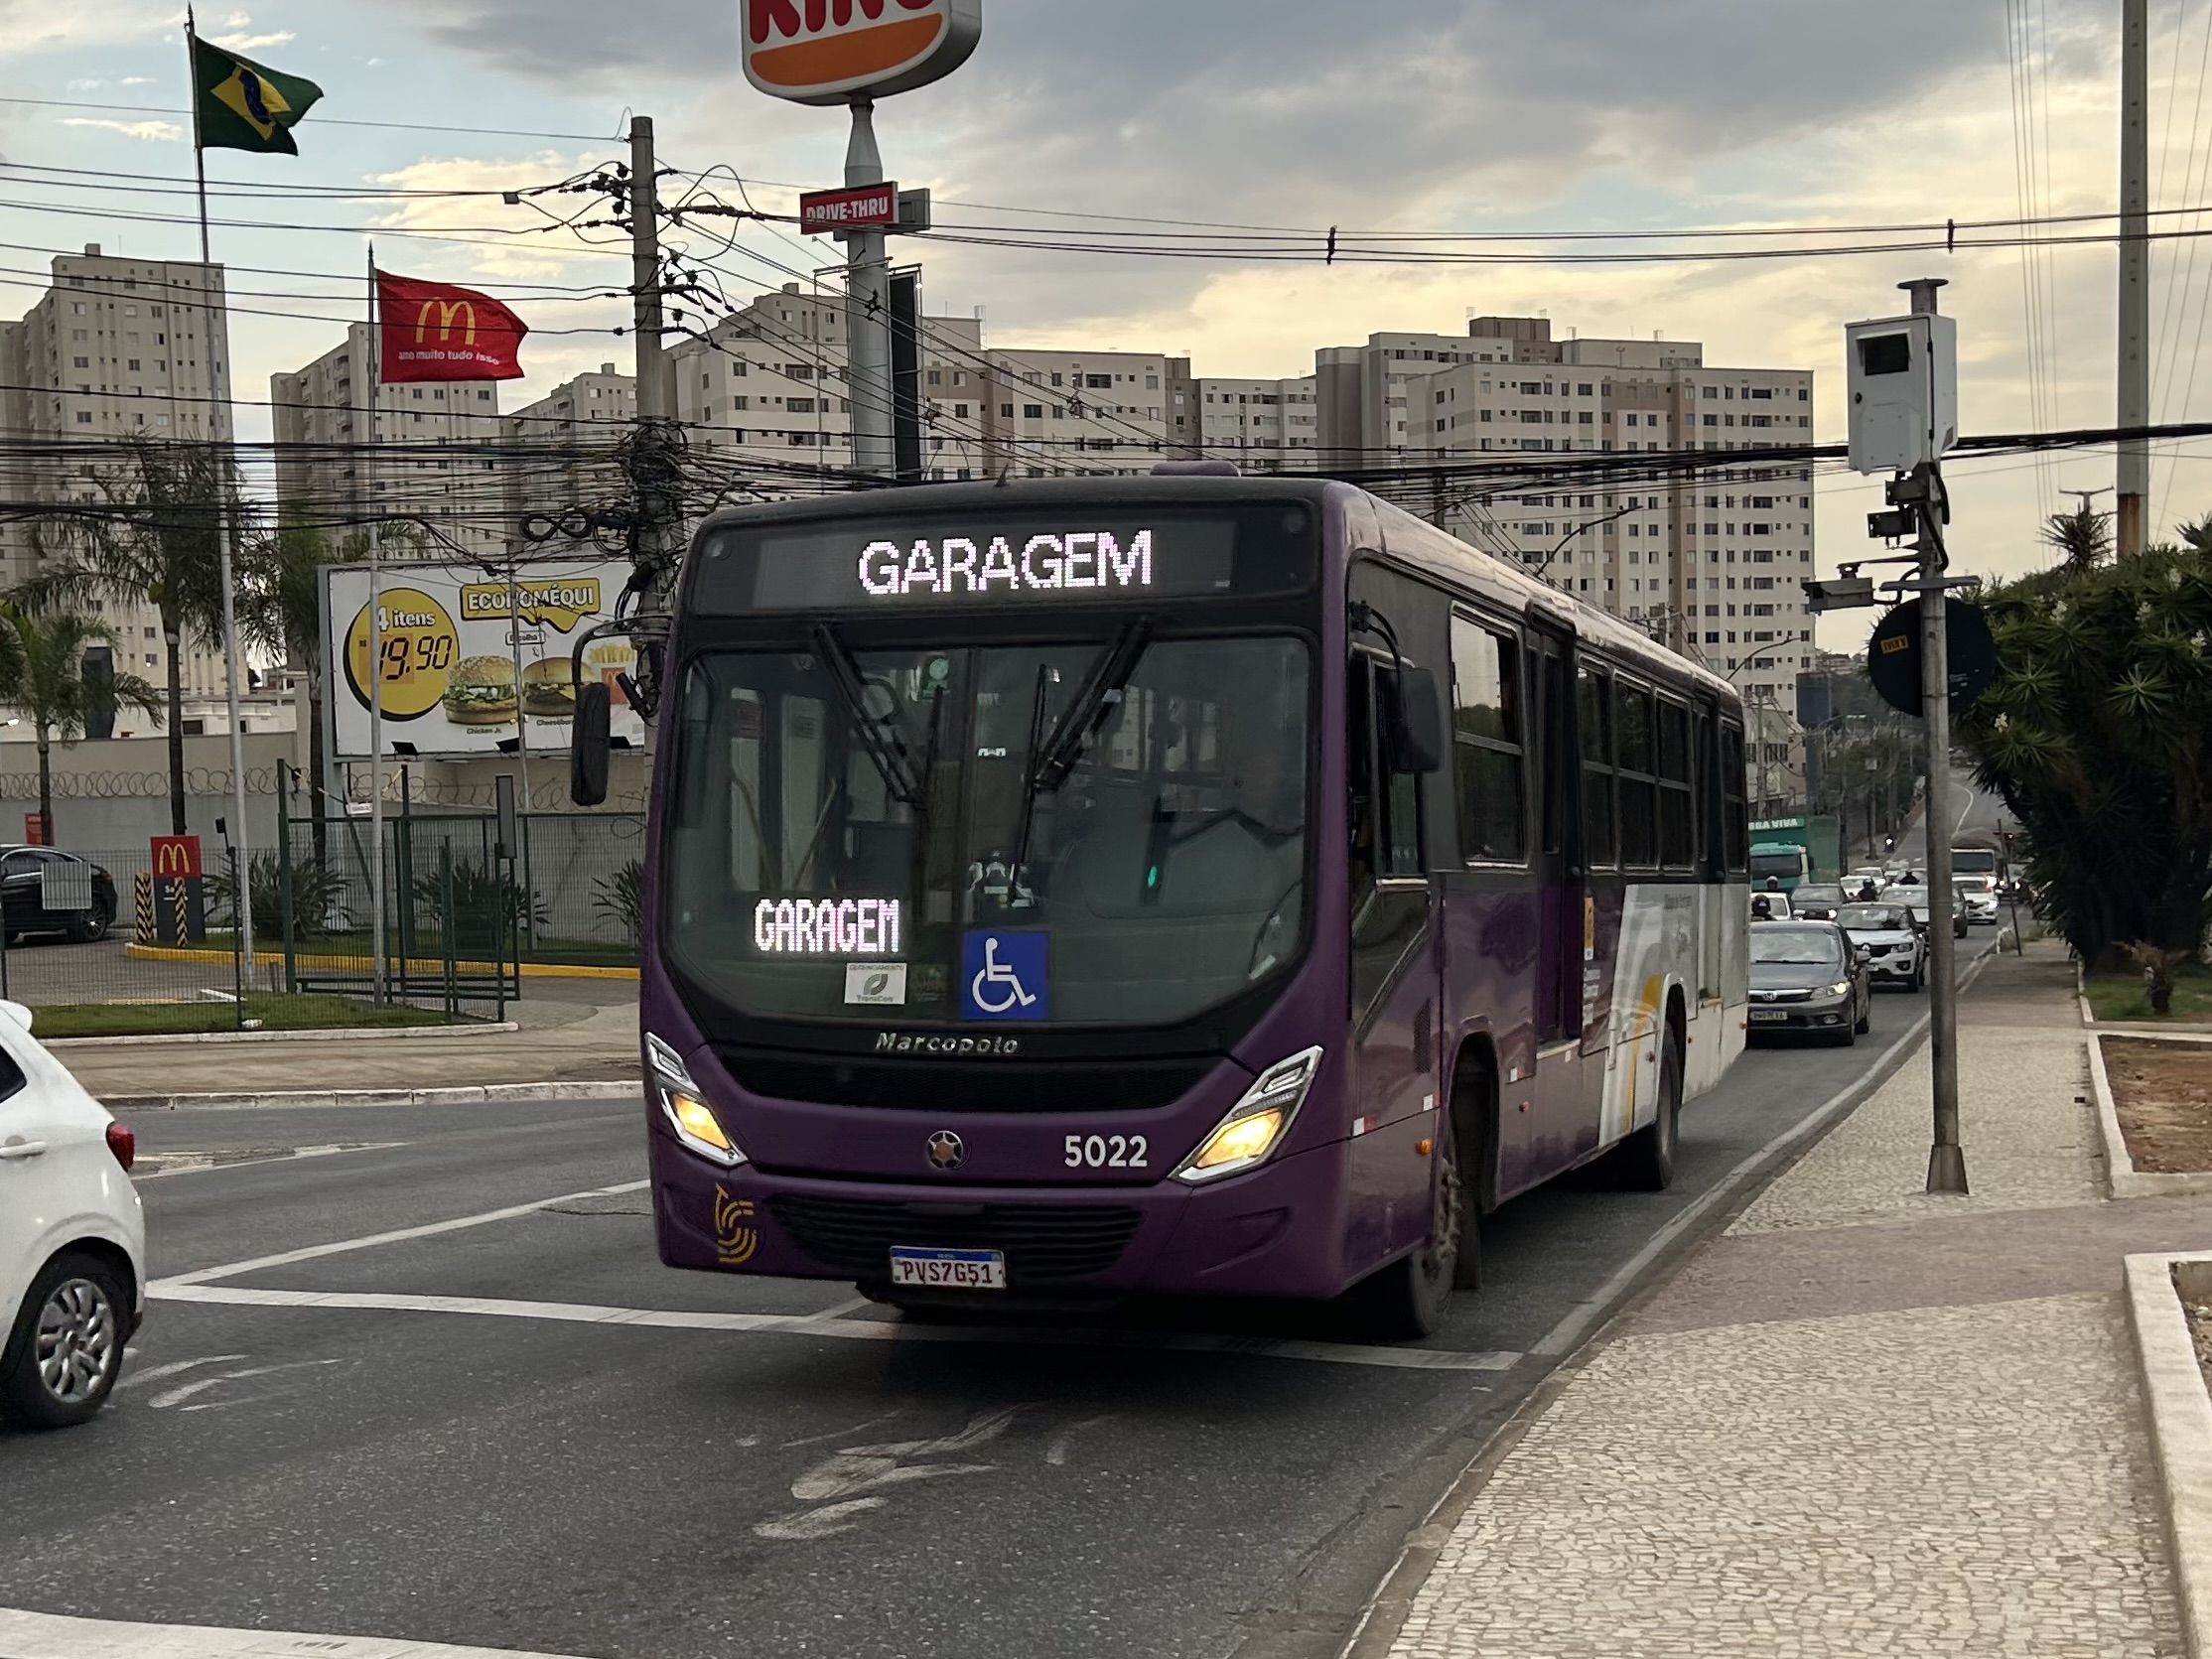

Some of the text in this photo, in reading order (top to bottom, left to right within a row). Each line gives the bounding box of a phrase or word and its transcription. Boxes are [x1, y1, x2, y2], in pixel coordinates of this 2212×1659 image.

[806, 197, 889, 221] DRIVE-THRU
[416, 349, 445, 360] muito
[448, 349, 474, 360] tudo
[859, 529, 1152, 595] GARAGEM
[393, 609, 437, 627] itens
[1771, 817, 1798, 829] VIVA
[755, 899, 899, 952] GARAGEM
[876, 1032, 1019, 1054] Marcopolo
[1064, 1135, 1148, 1168] 5022
[901, 1261, 994, 1285] PVS7G51
